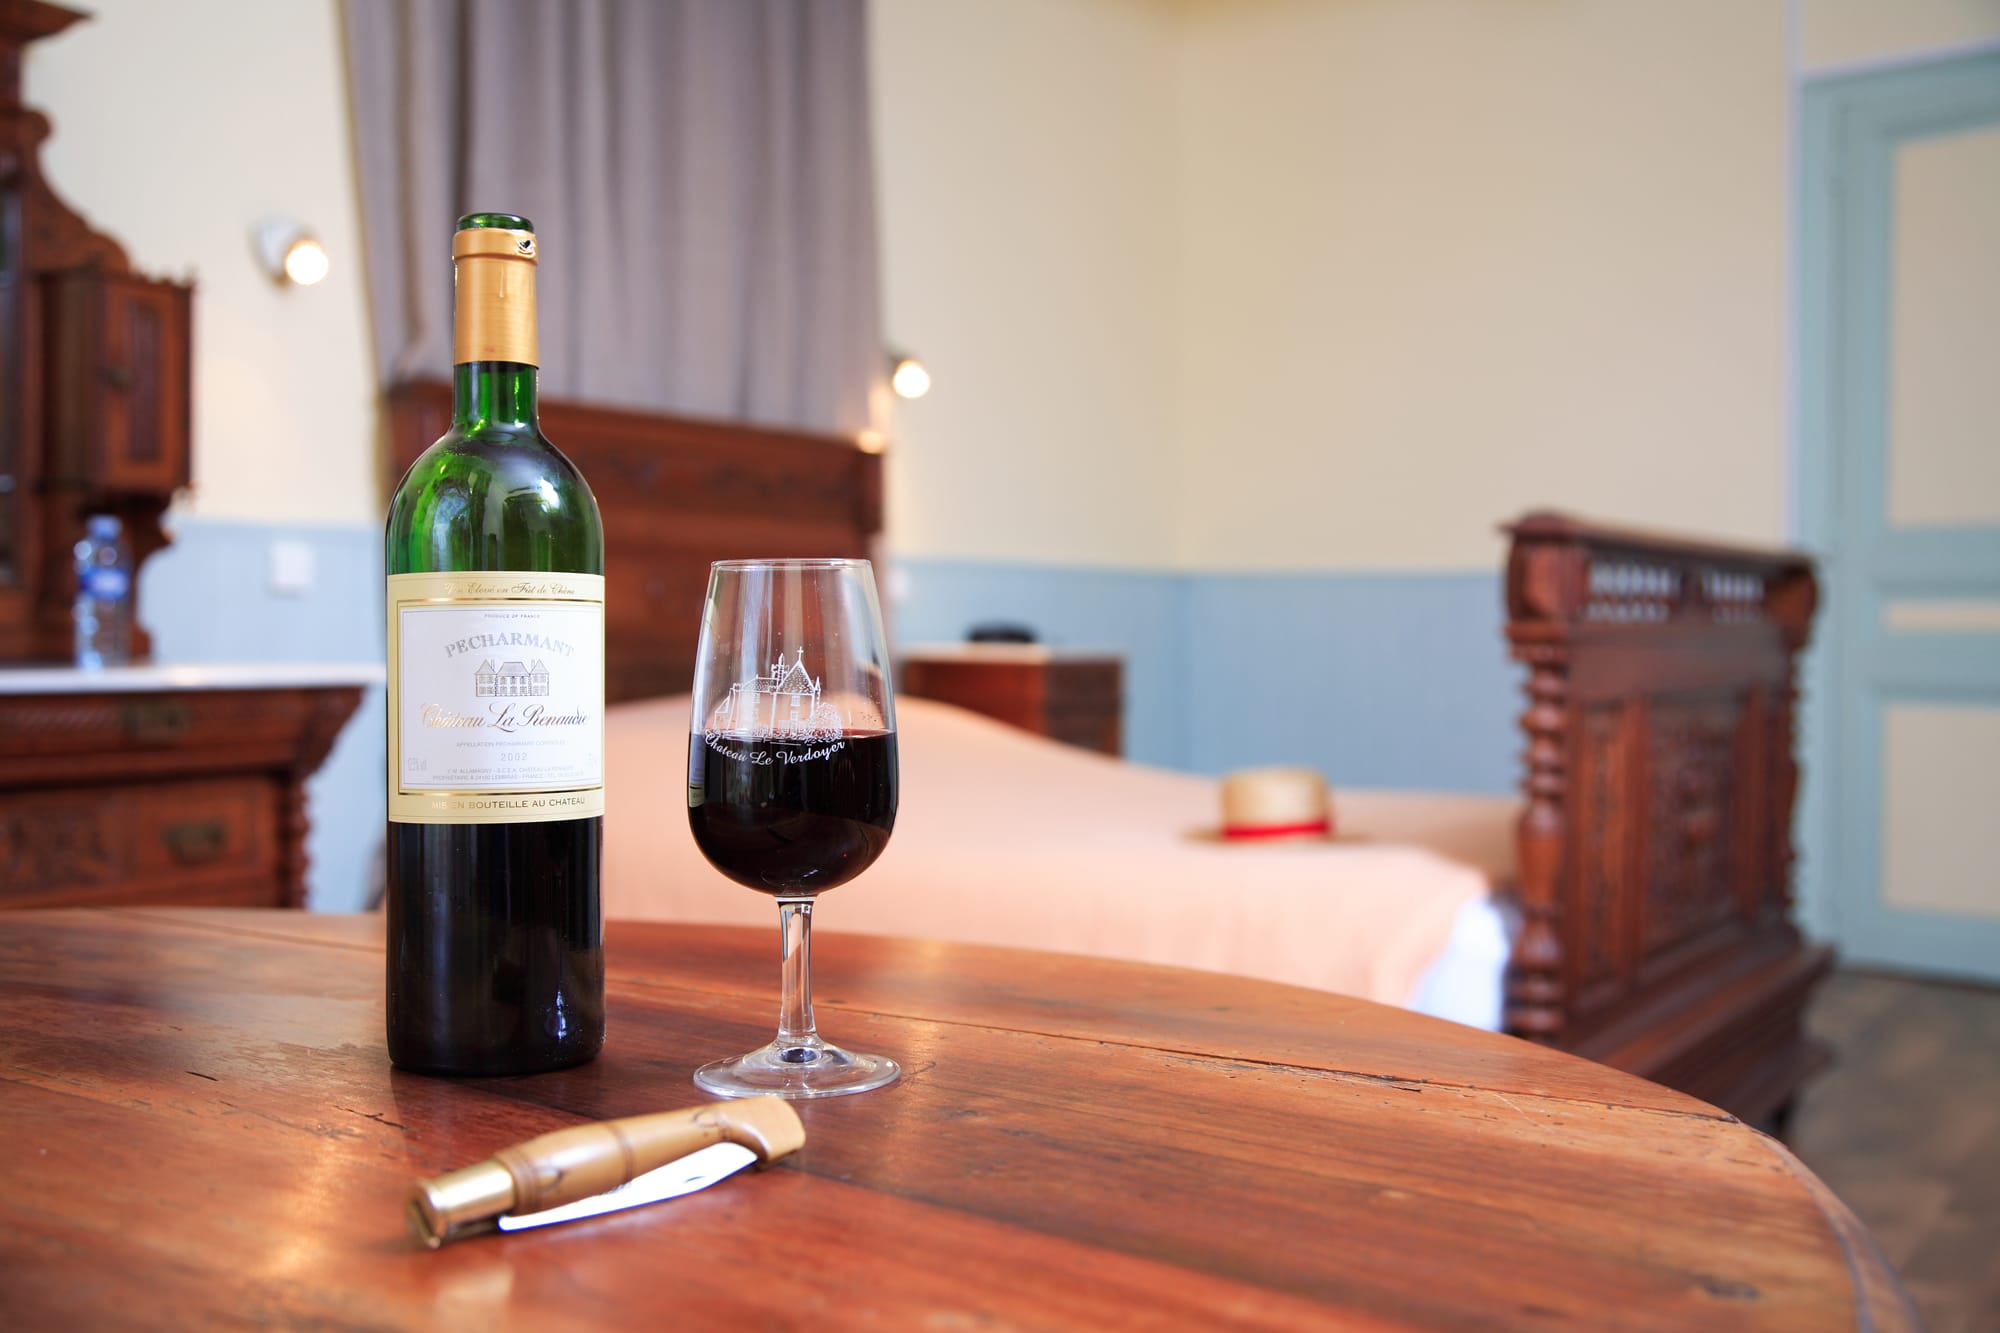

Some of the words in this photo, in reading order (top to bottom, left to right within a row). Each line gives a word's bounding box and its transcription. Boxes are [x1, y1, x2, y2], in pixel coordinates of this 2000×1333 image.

[444, 632, 574, 658] PECHARMANT
[487, 702, 518, 733] La
[517, 703, 588, 727] Renaudie
[500, 752, 528, 761] 2002
[705, 729, 748, 761] Chateau
[749, 751, 773, 765] Le
[775, 740, 846, 765] Verdoyer
[451, 801, 465, 809] EN
[469, 800, 529, 809] BOUTEILLE
[532, 800, 546, 808] AU
[549, 797, 585, 807] CHATEAU
